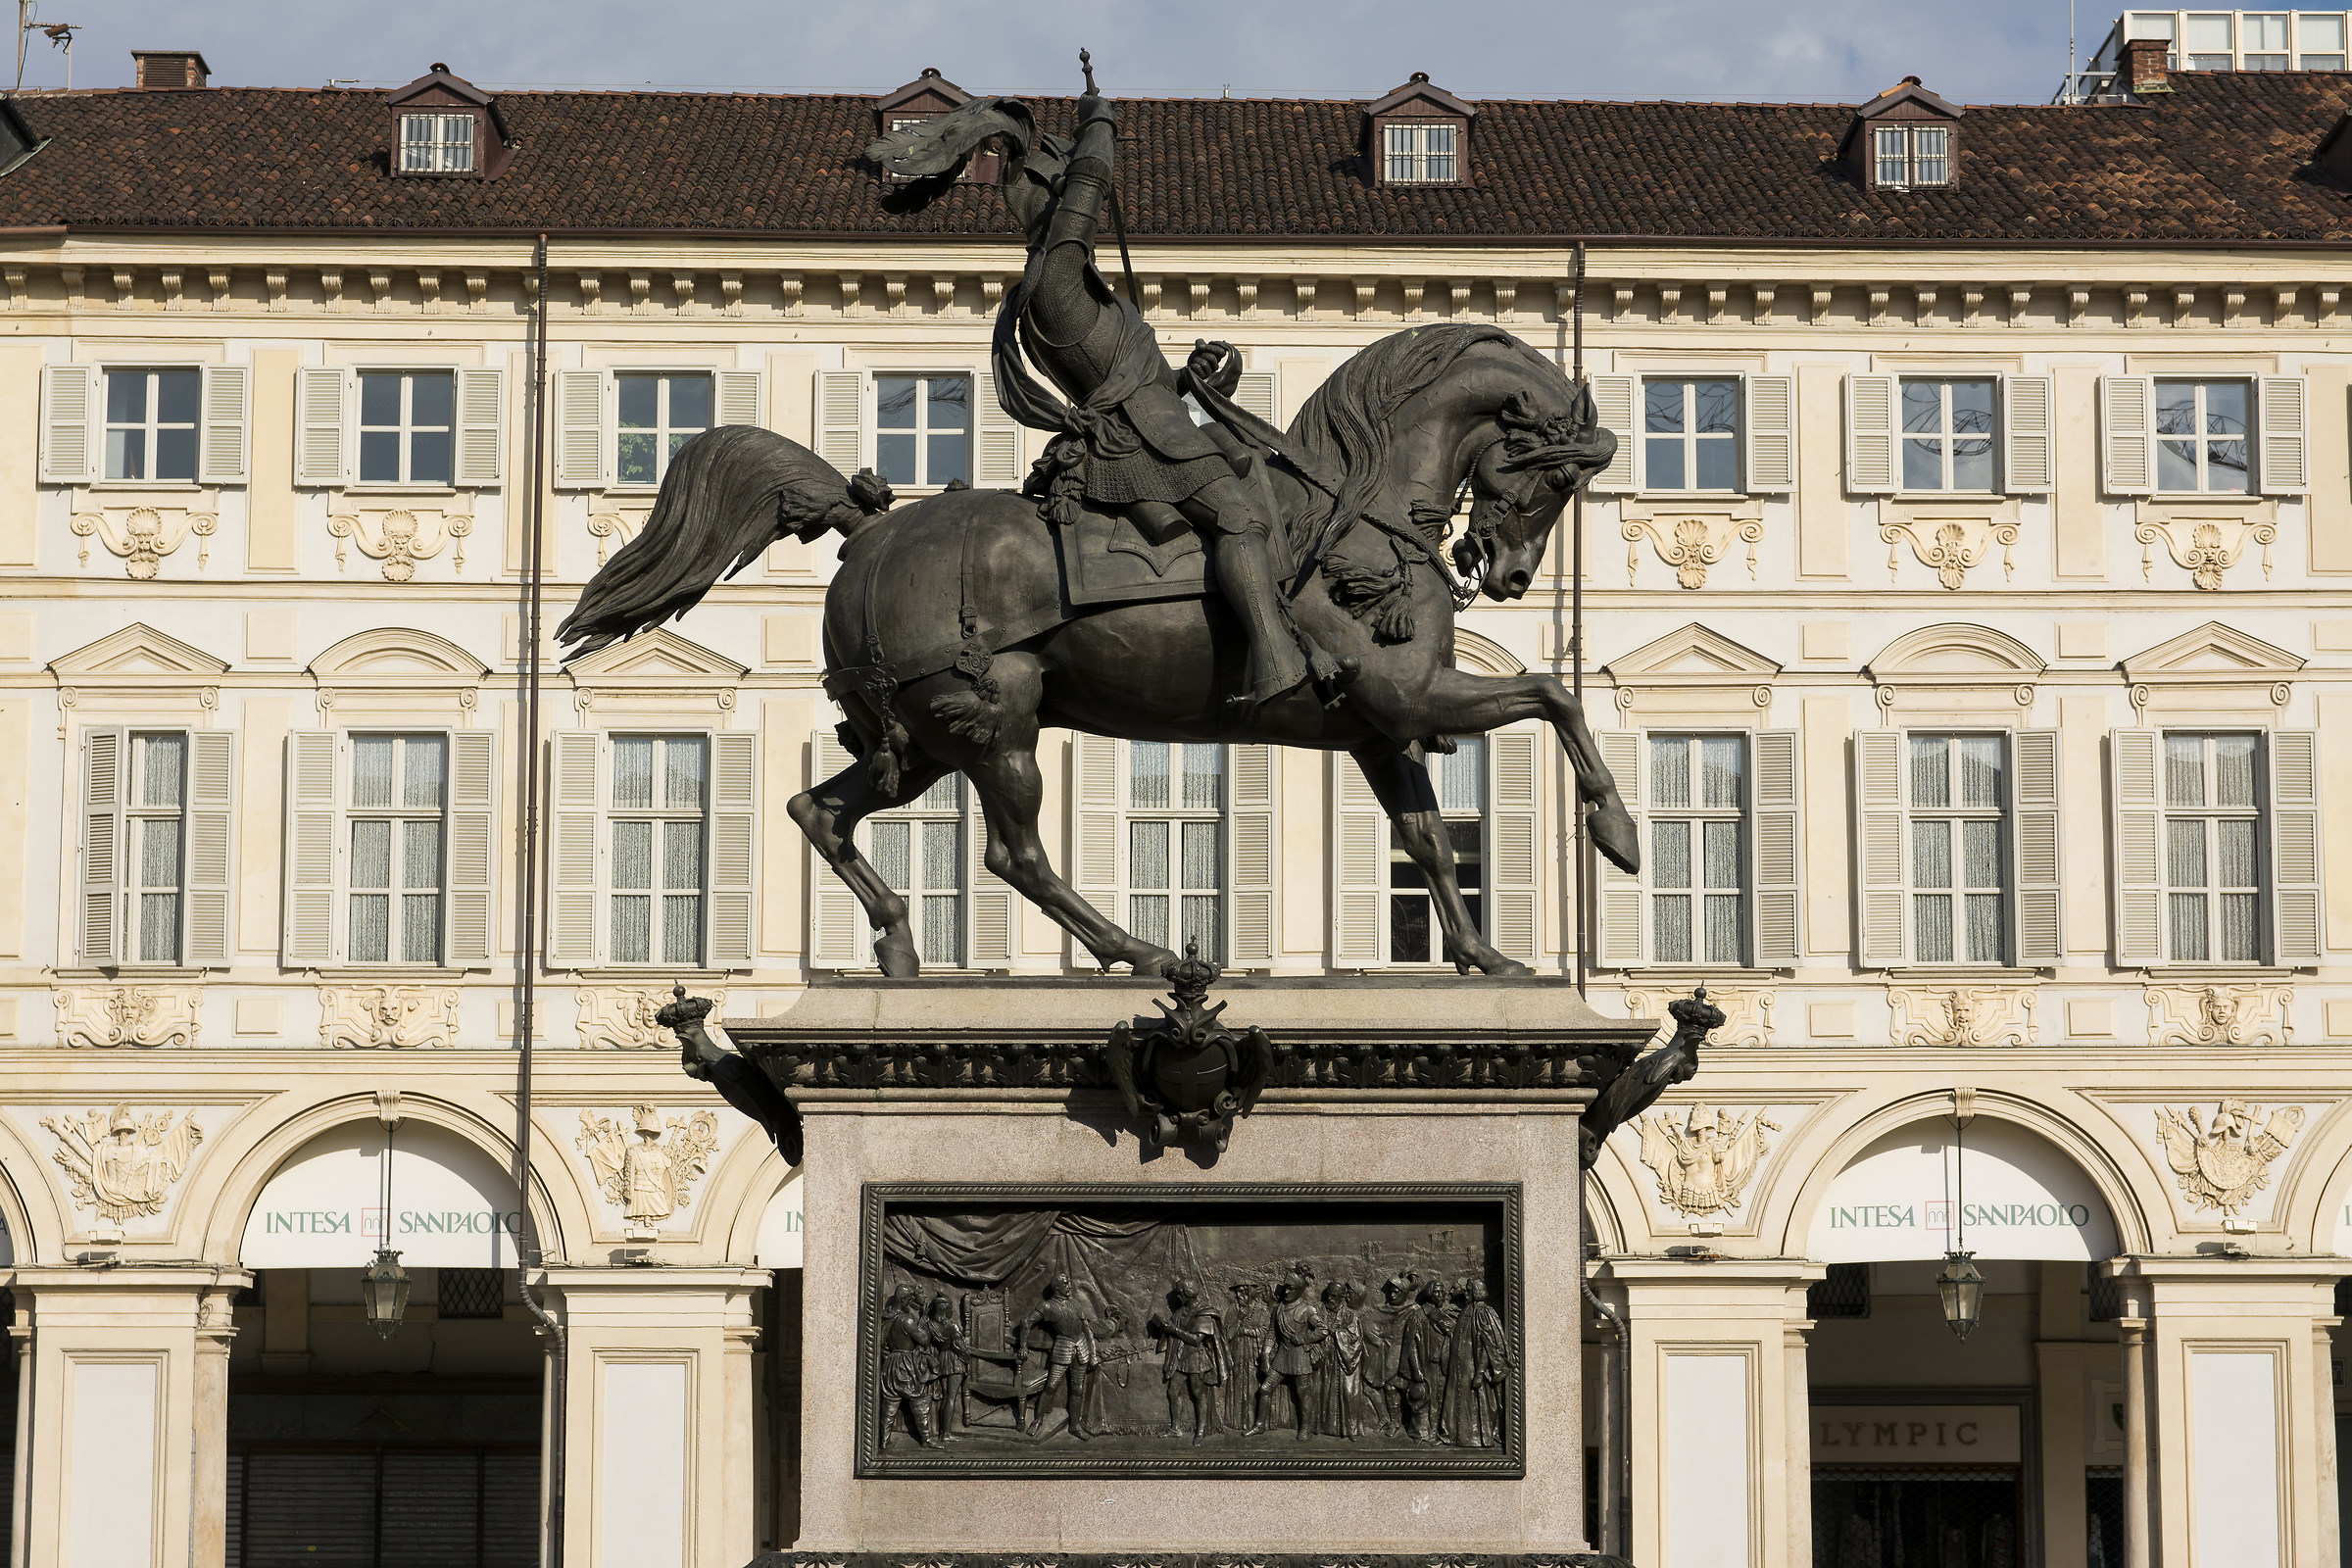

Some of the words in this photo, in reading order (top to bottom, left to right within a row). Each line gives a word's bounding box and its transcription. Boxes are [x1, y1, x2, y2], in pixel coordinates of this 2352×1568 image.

[266, 1211, 351, 1234] INTESA
[1830, 1205, 1916, 1228] INTESA
[1963, 1203, 2089, 1227] SANPAOLO
